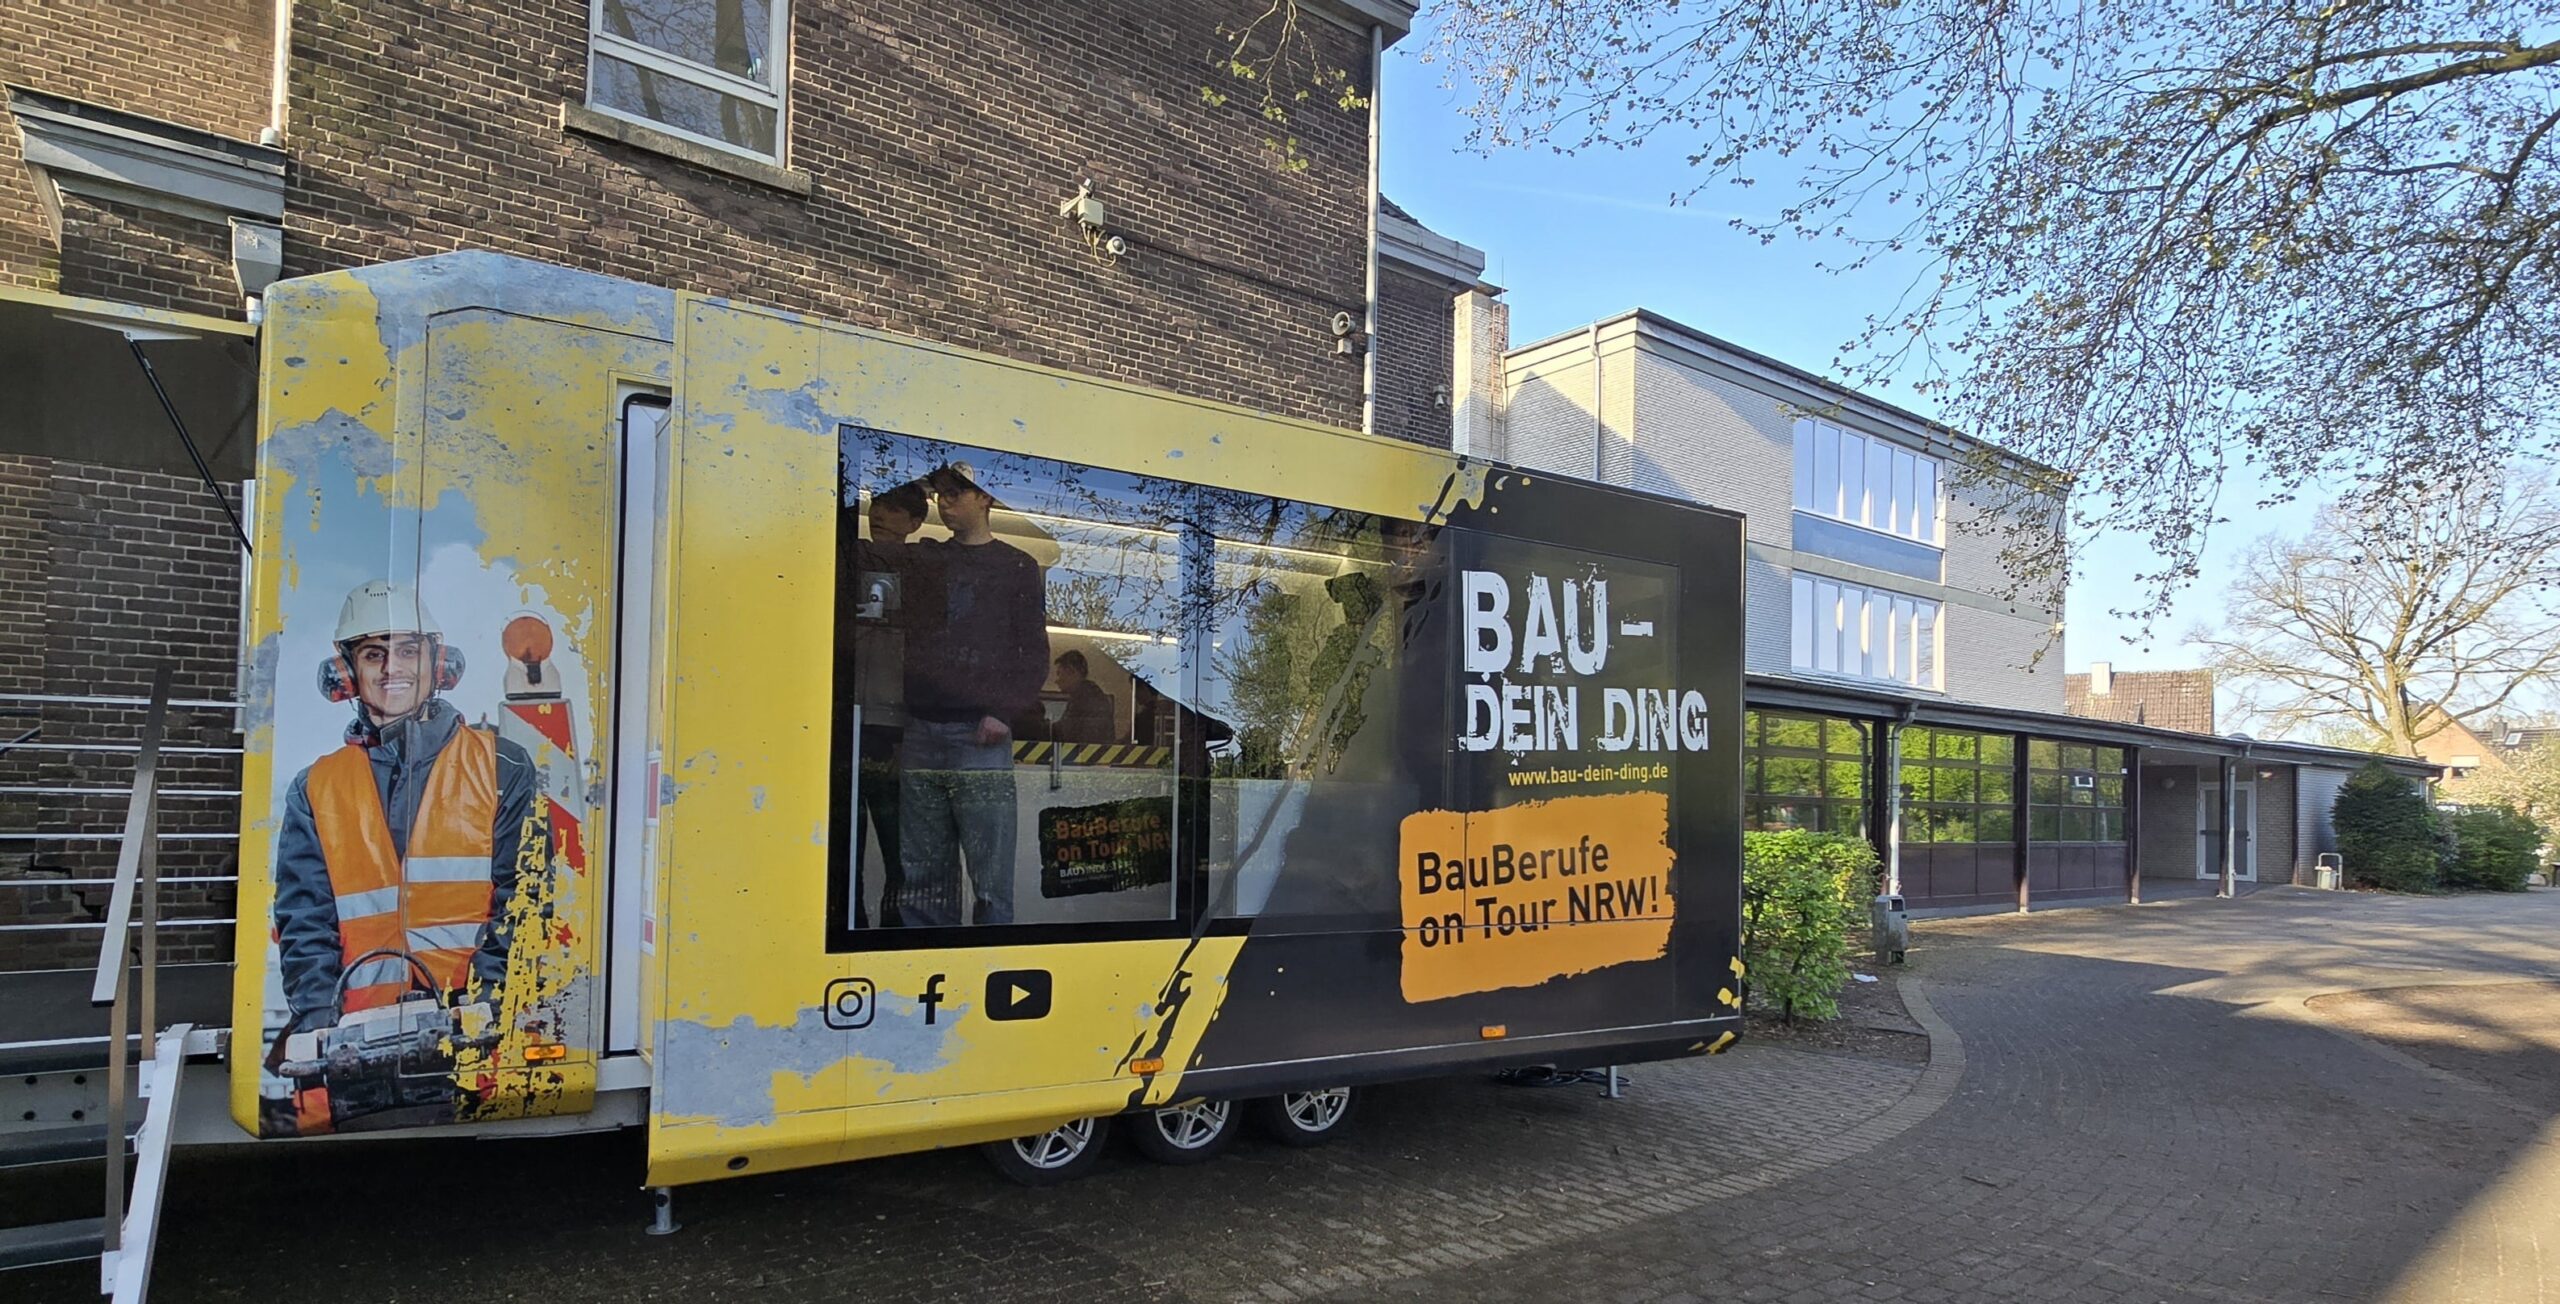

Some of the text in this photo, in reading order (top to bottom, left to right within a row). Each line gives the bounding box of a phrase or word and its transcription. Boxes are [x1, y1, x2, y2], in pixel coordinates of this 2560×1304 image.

[1462, 566, 1654, 676] BAU-
[1461, 684, 1709, 753] DEIN DING
[1508, 762, 1669, 787] www.bau-dein-ding.de
[1056, 845, 1082, 862] on
[1416, 834, 1610, 895] BauBerufe
[1419, 875, 1659, 948] on Tour NRW!
